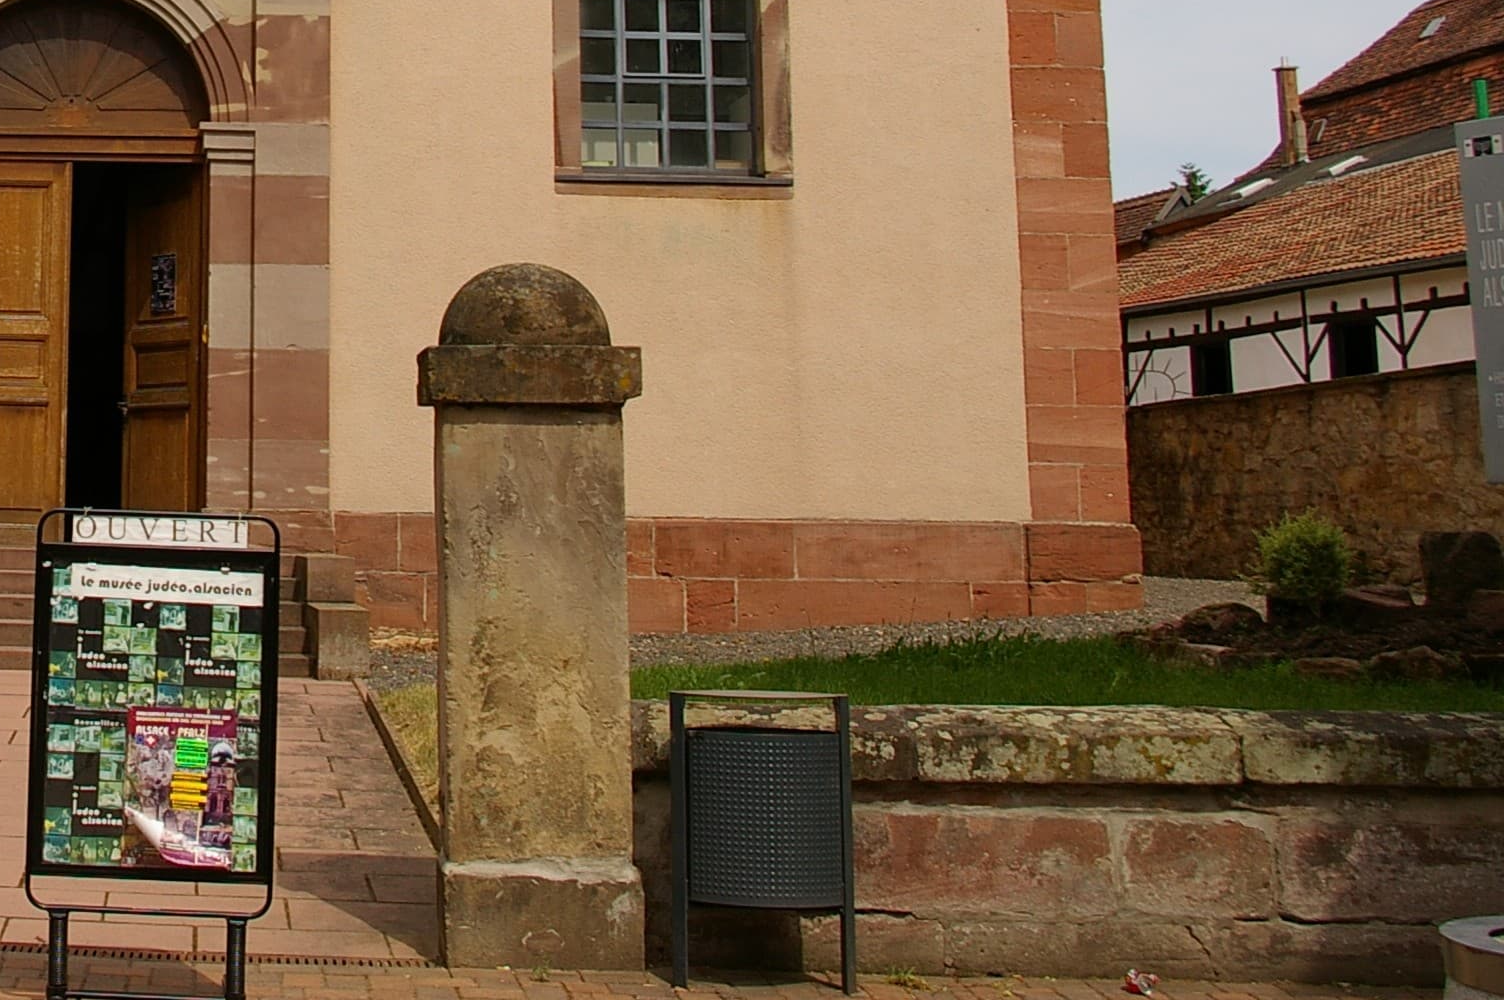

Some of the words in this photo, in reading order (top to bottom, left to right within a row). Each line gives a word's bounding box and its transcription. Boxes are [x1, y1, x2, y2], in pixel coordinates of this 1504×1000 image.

[1476, 202, 1494, 233] LE
[76, 516, 246, 543] OUVERT
[99, 578, 142, 590] musée
